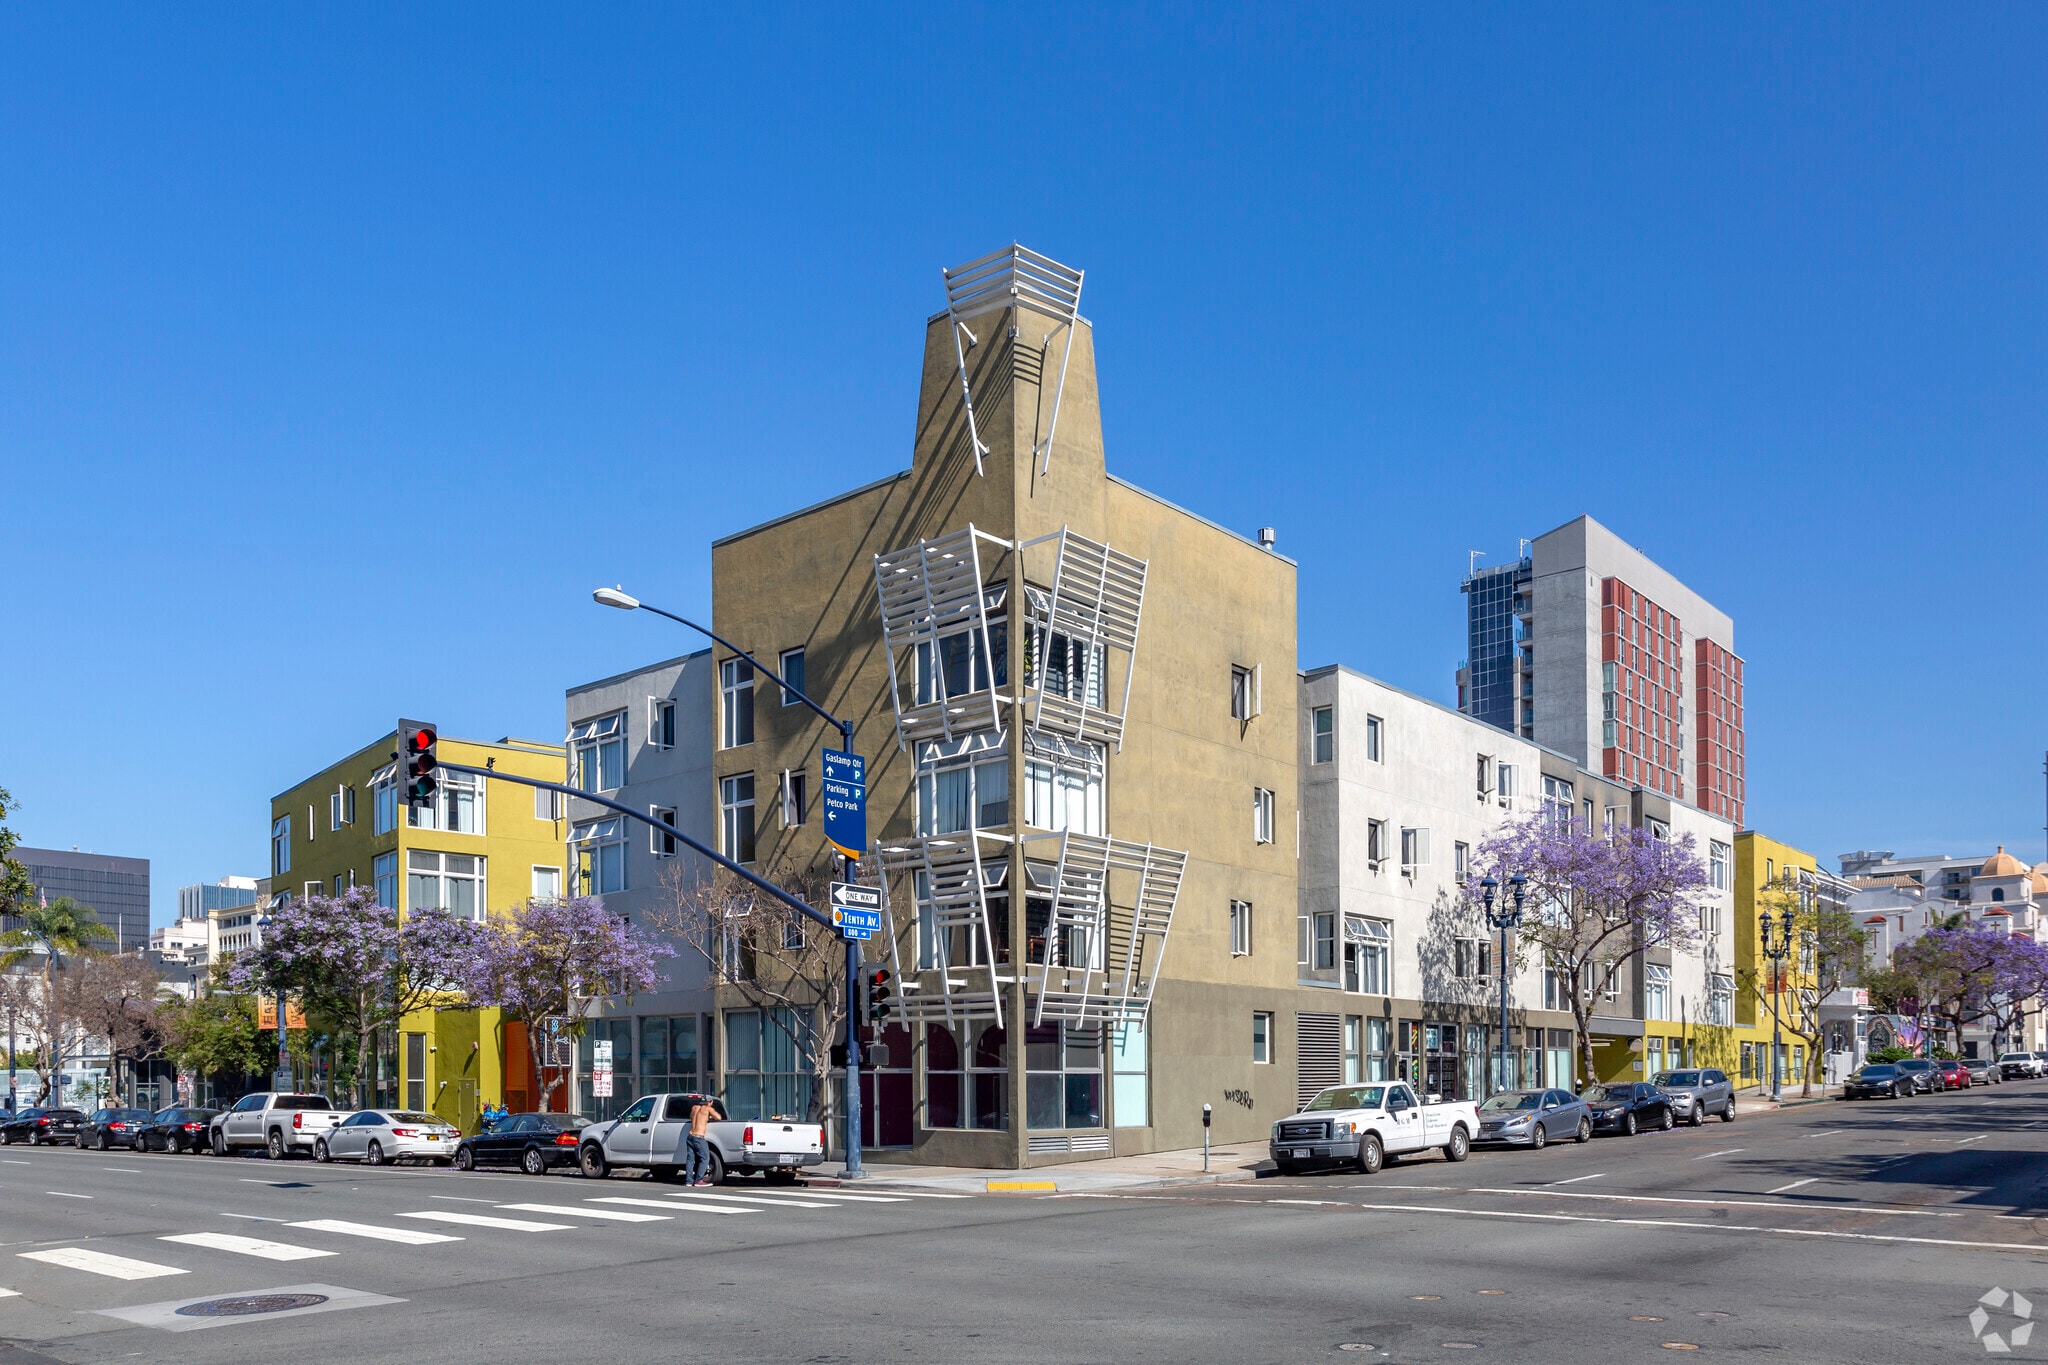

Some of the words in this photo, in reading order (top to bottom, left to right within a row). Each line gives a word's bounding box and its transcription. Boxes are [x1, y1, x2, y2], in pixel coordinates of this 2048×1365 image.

[826, 753, 851, 767] Gaslamp
[852, 759, 862, 768] Qtr
[855, 770, 861, 780] P
[826, 784, 849, 797] Parking
[855, 789, 861, 799] P
[827, 797, 844, 809] Petco
[845, 801, 859, 811] Park
[845, 891, 858, 900] ONE
[860, 894, 874, 902] WAY
[843, 911, 865, 926] TENTH
[867, 915, 879, 928] AV.
